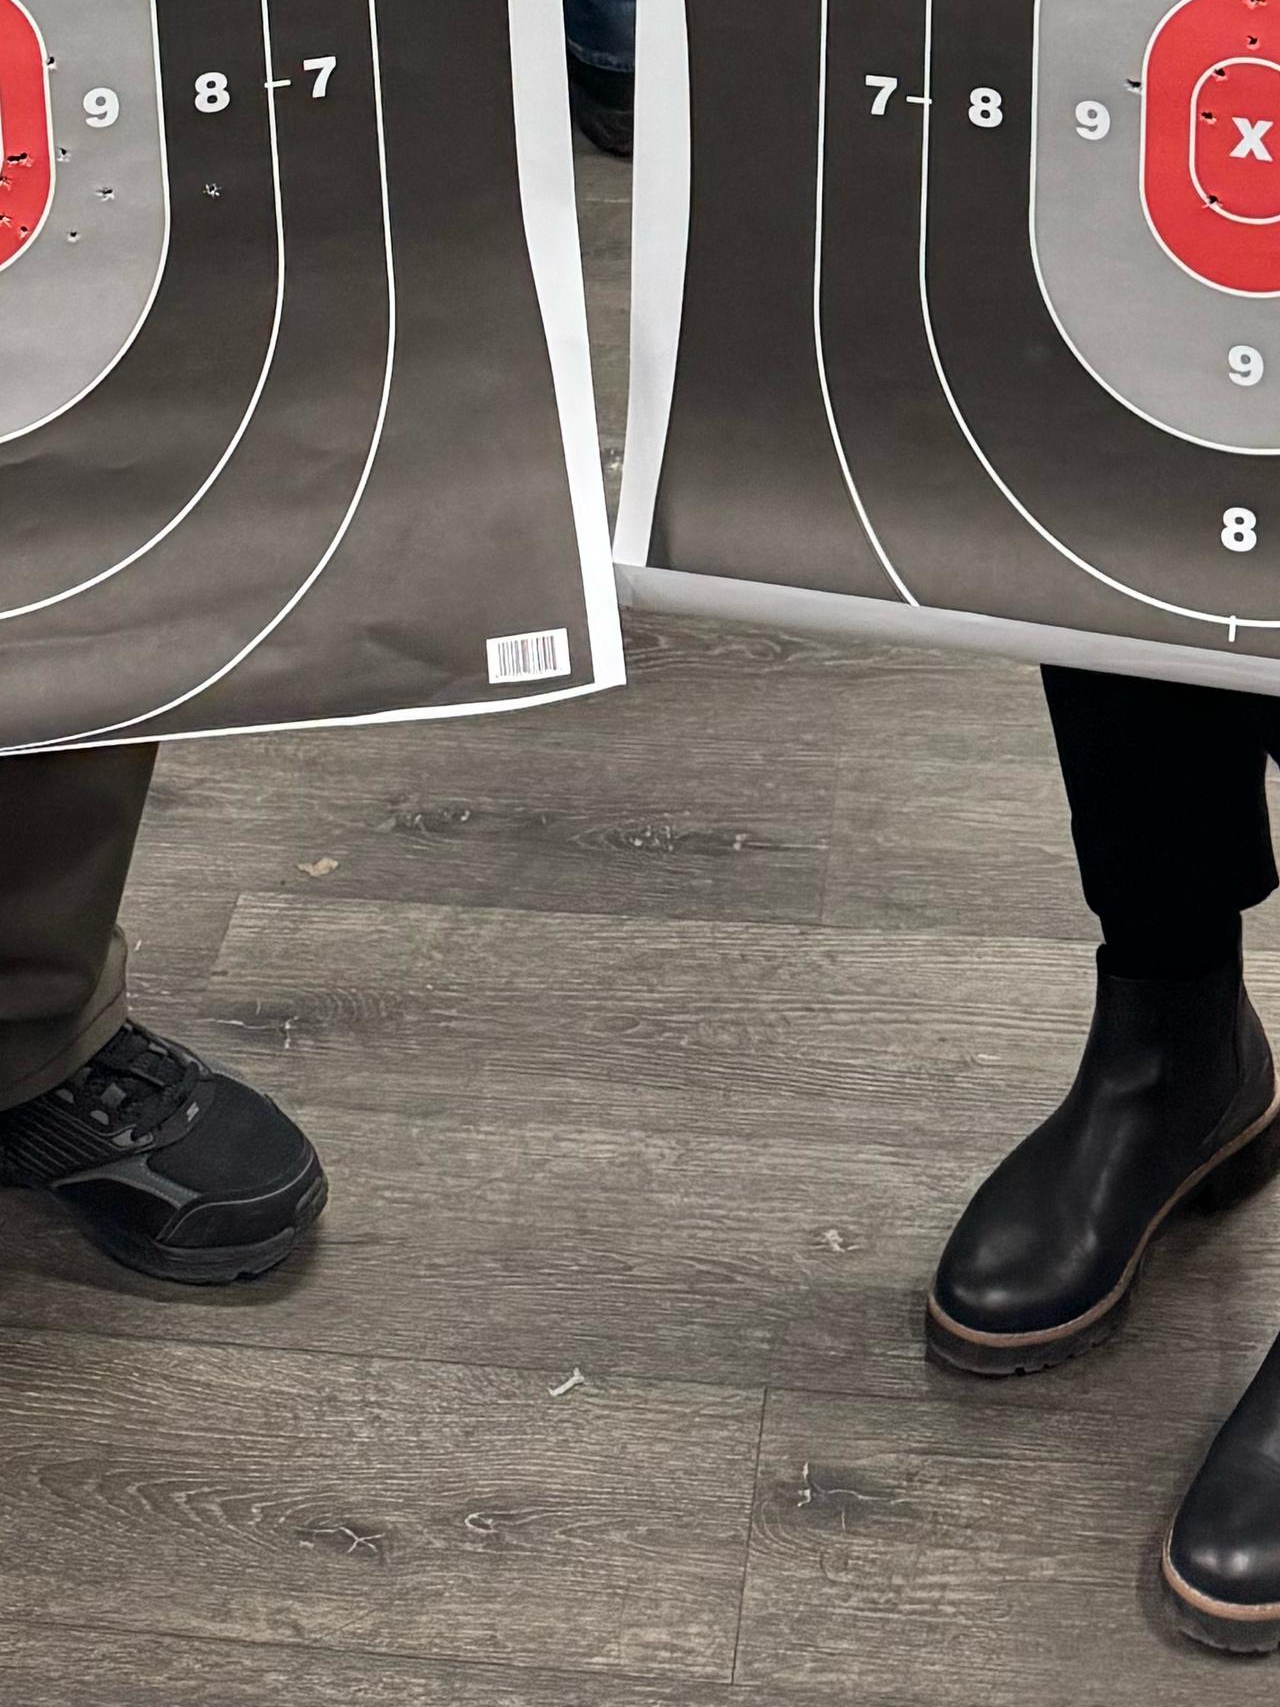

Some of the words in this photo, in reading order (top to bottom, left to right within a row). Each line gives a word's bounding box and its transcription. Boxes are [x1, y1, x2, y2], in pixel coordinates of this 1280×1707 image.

[194, 72, 231, 113] 8
[303, 56, 337, 98] 7
[865, 74, 898, 116] 7
[82, 87, 120, 128] 9
[968, 87, 1003, 128] 8
[1074, 100, 1111, 140] 9
[1229, 118, 1274, 163] X
[1227, 345, 1265, 387] 9
[1220, 506, 1258, 553] 8
